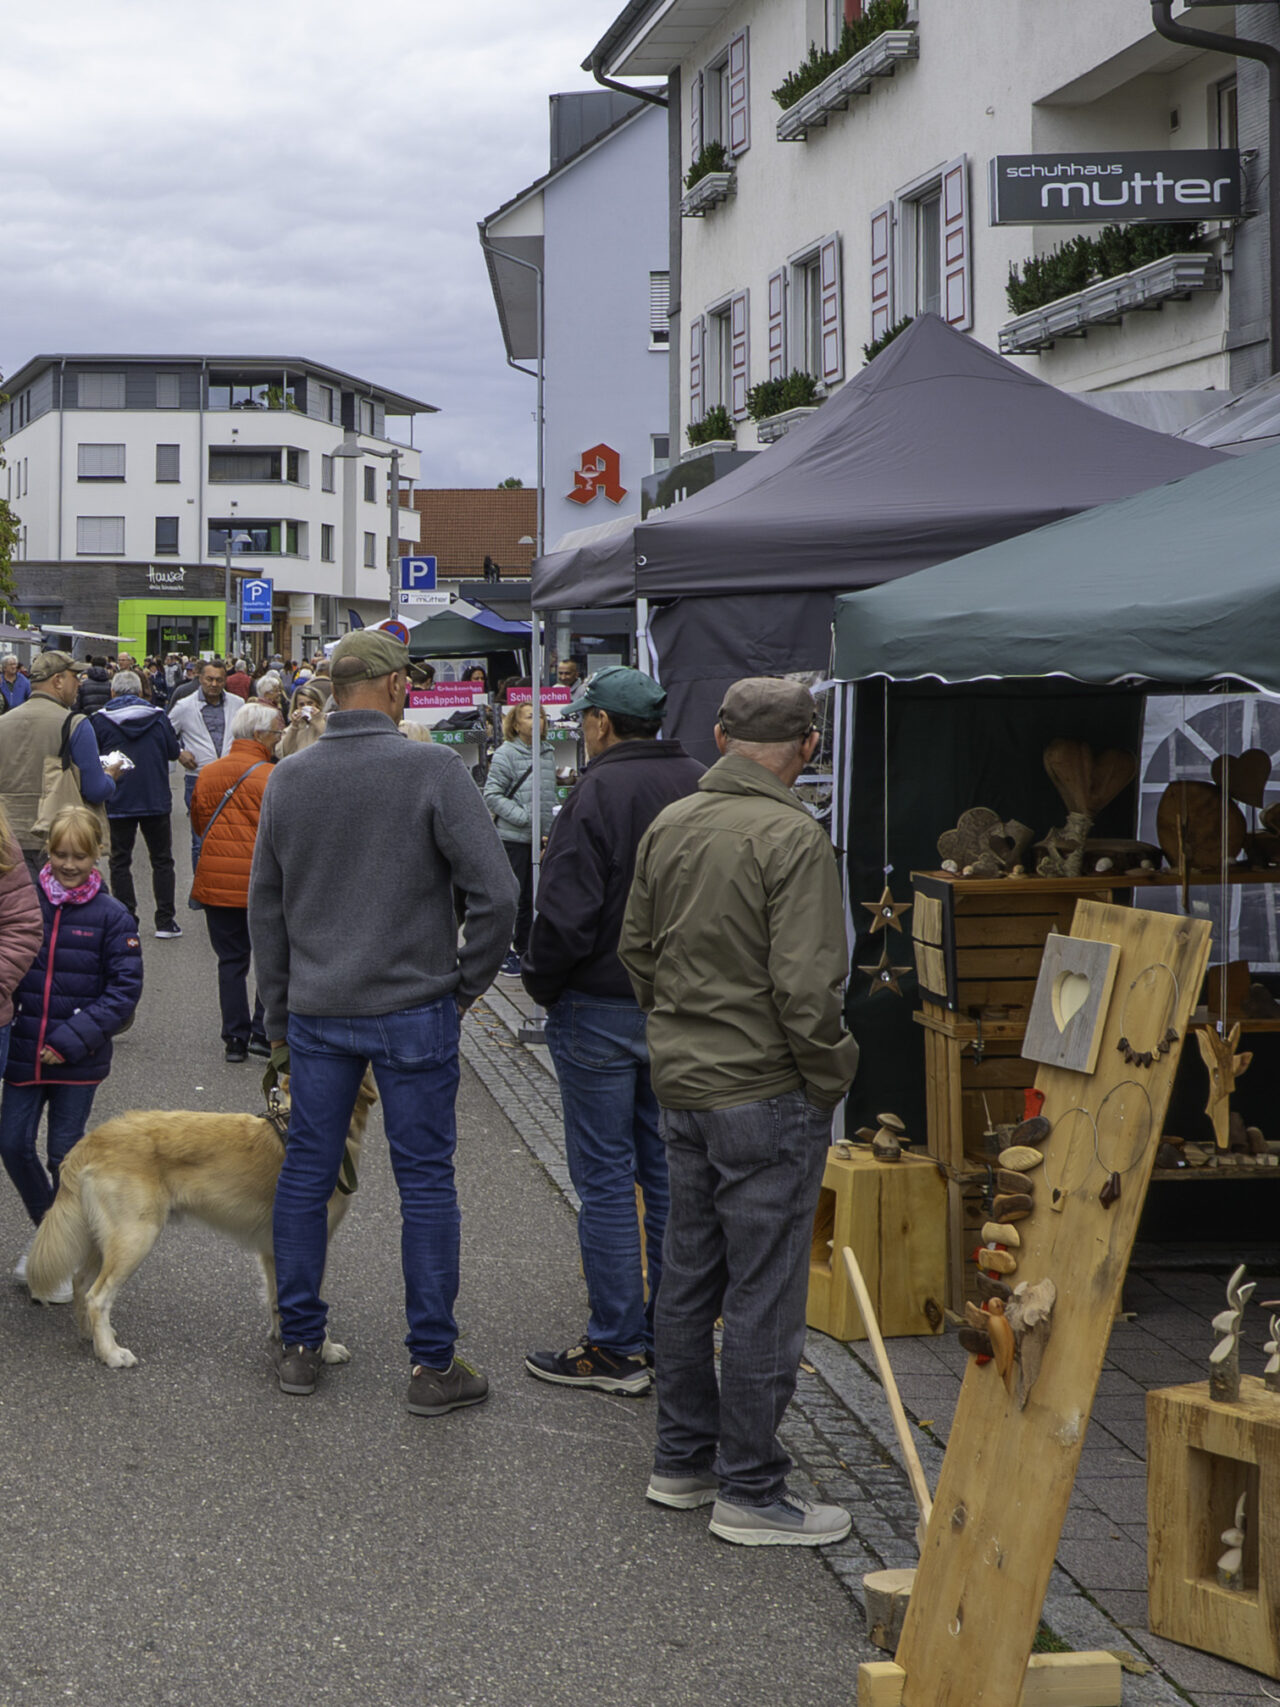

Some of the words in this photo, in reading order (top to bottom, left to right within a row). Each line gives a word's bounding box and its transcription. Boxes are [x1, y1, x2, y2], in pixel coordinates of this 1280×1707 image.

[1006, 163, 1123, 178] schuhhaus
[1041, 171, 1231, 208] mutter
[145, 564, 187, 584] Hauser
[409, 561, 429, 587] P
[252, 586, 262, 601] P
[413, 695, 471, 706] Schnäppchen
[510, 692, 568, 703] Schnpchen
[443, 733, 453, 742] 20
[455, 733, 461, 742] €
